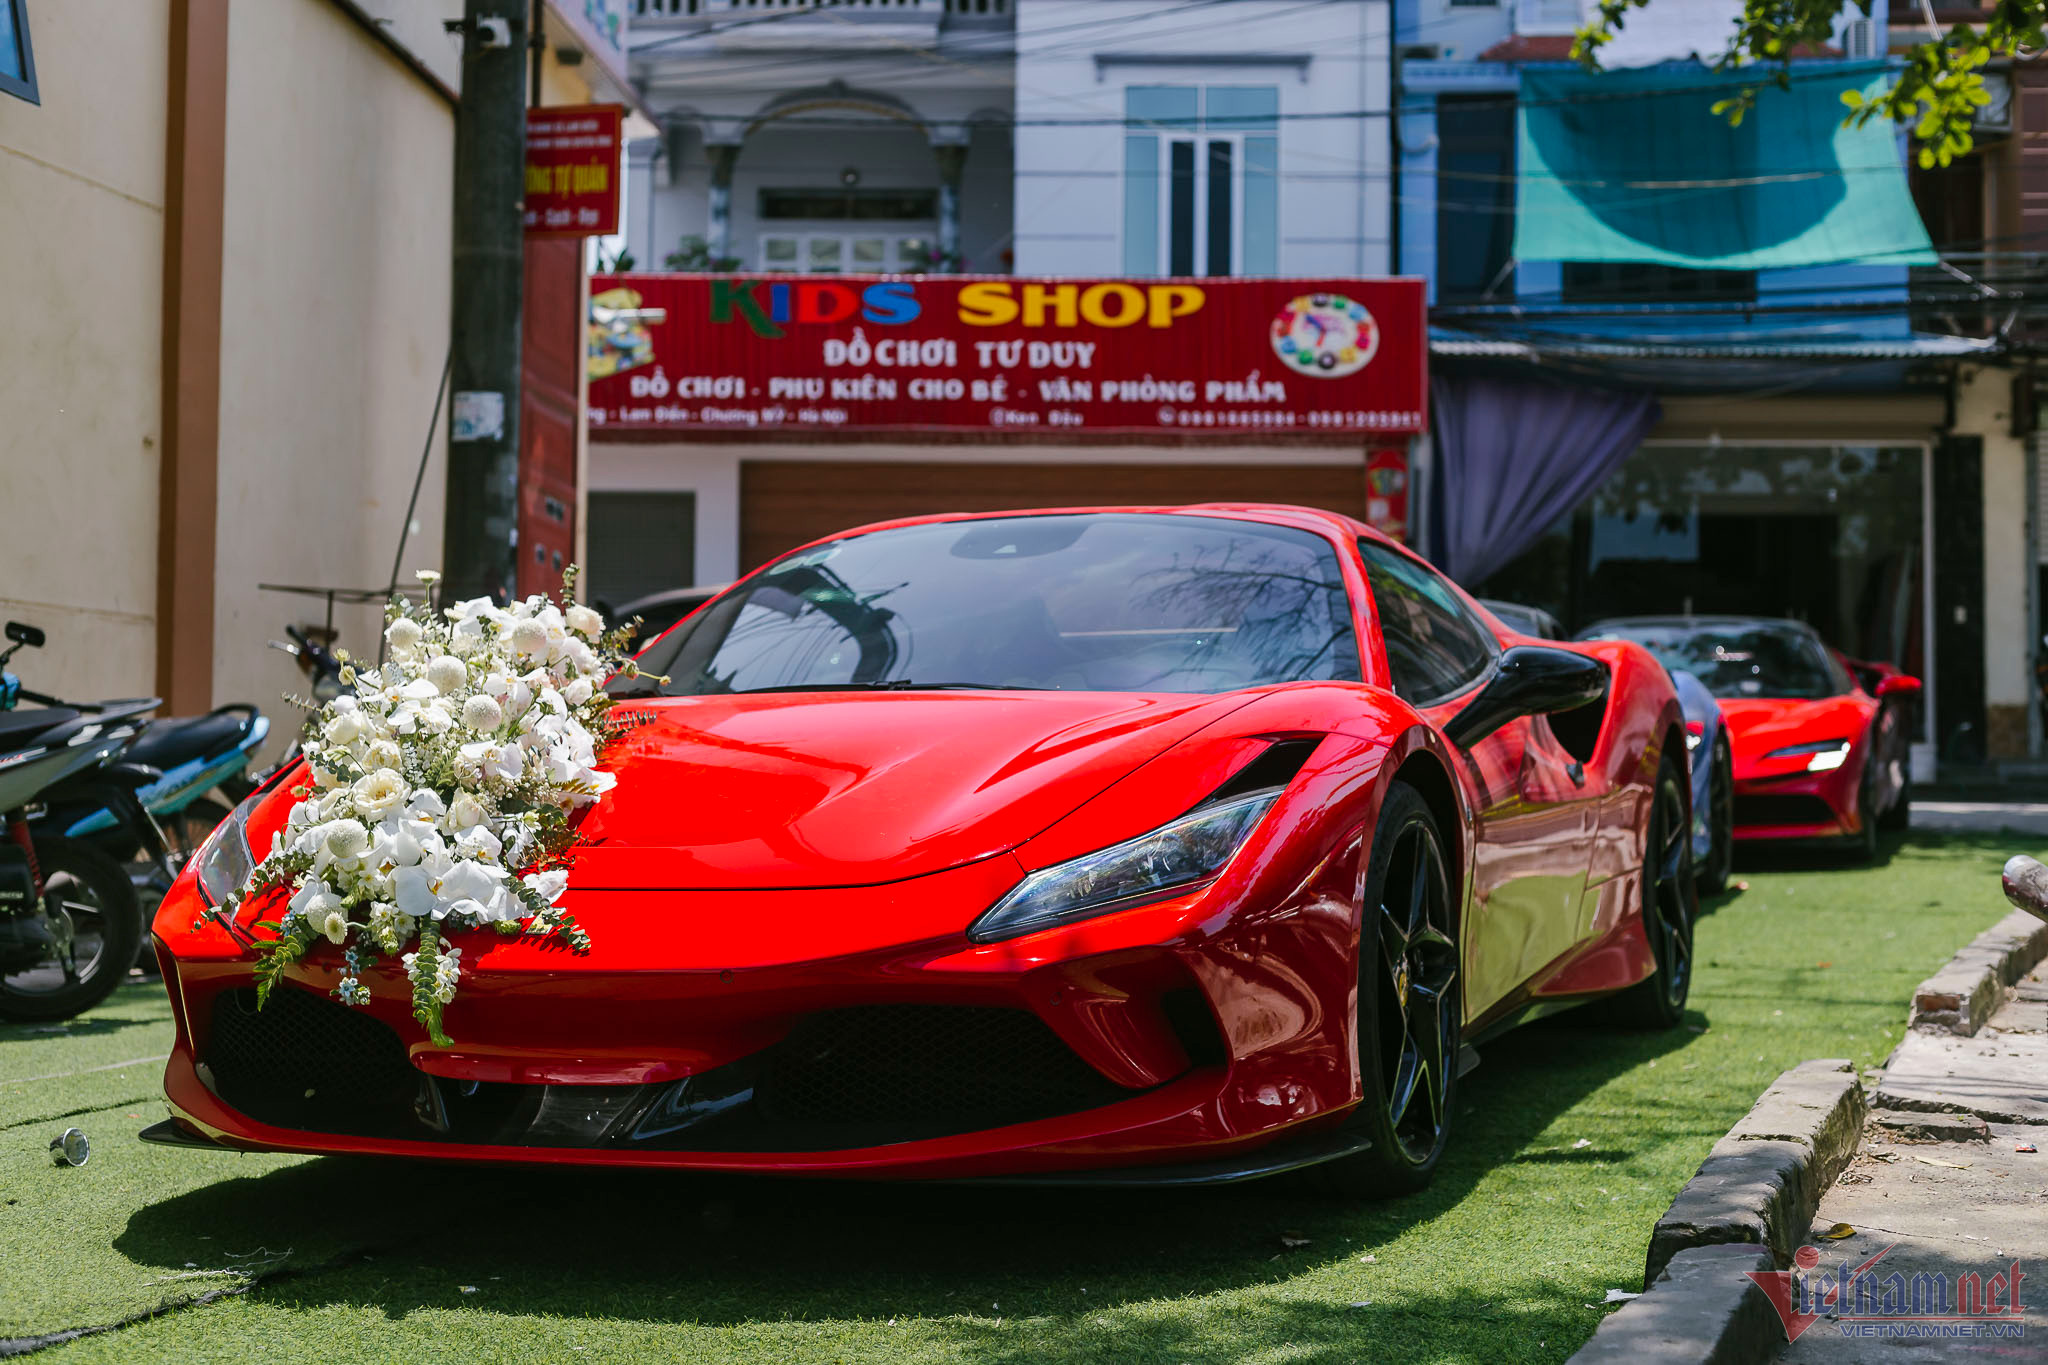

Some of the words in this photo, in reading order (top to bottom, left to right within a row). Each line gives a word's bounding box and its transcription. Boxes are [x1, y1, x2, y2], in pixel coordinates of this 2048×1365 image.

[709, 279, 922, 339] KIDS
[958, 283, 1206, 328] SHOP
[823, 326, 872, 367] ĐỒ
[874, 337, 957, 367] CHƠI
[974, 339, 1024, 368] TƯ
[1028, 341, 1096, 368] DUY
[630, 365, 670, 399] ĐỒ
[677, 376, 745, 399] CHƠI
[908, 378, 965, 400] CHO
